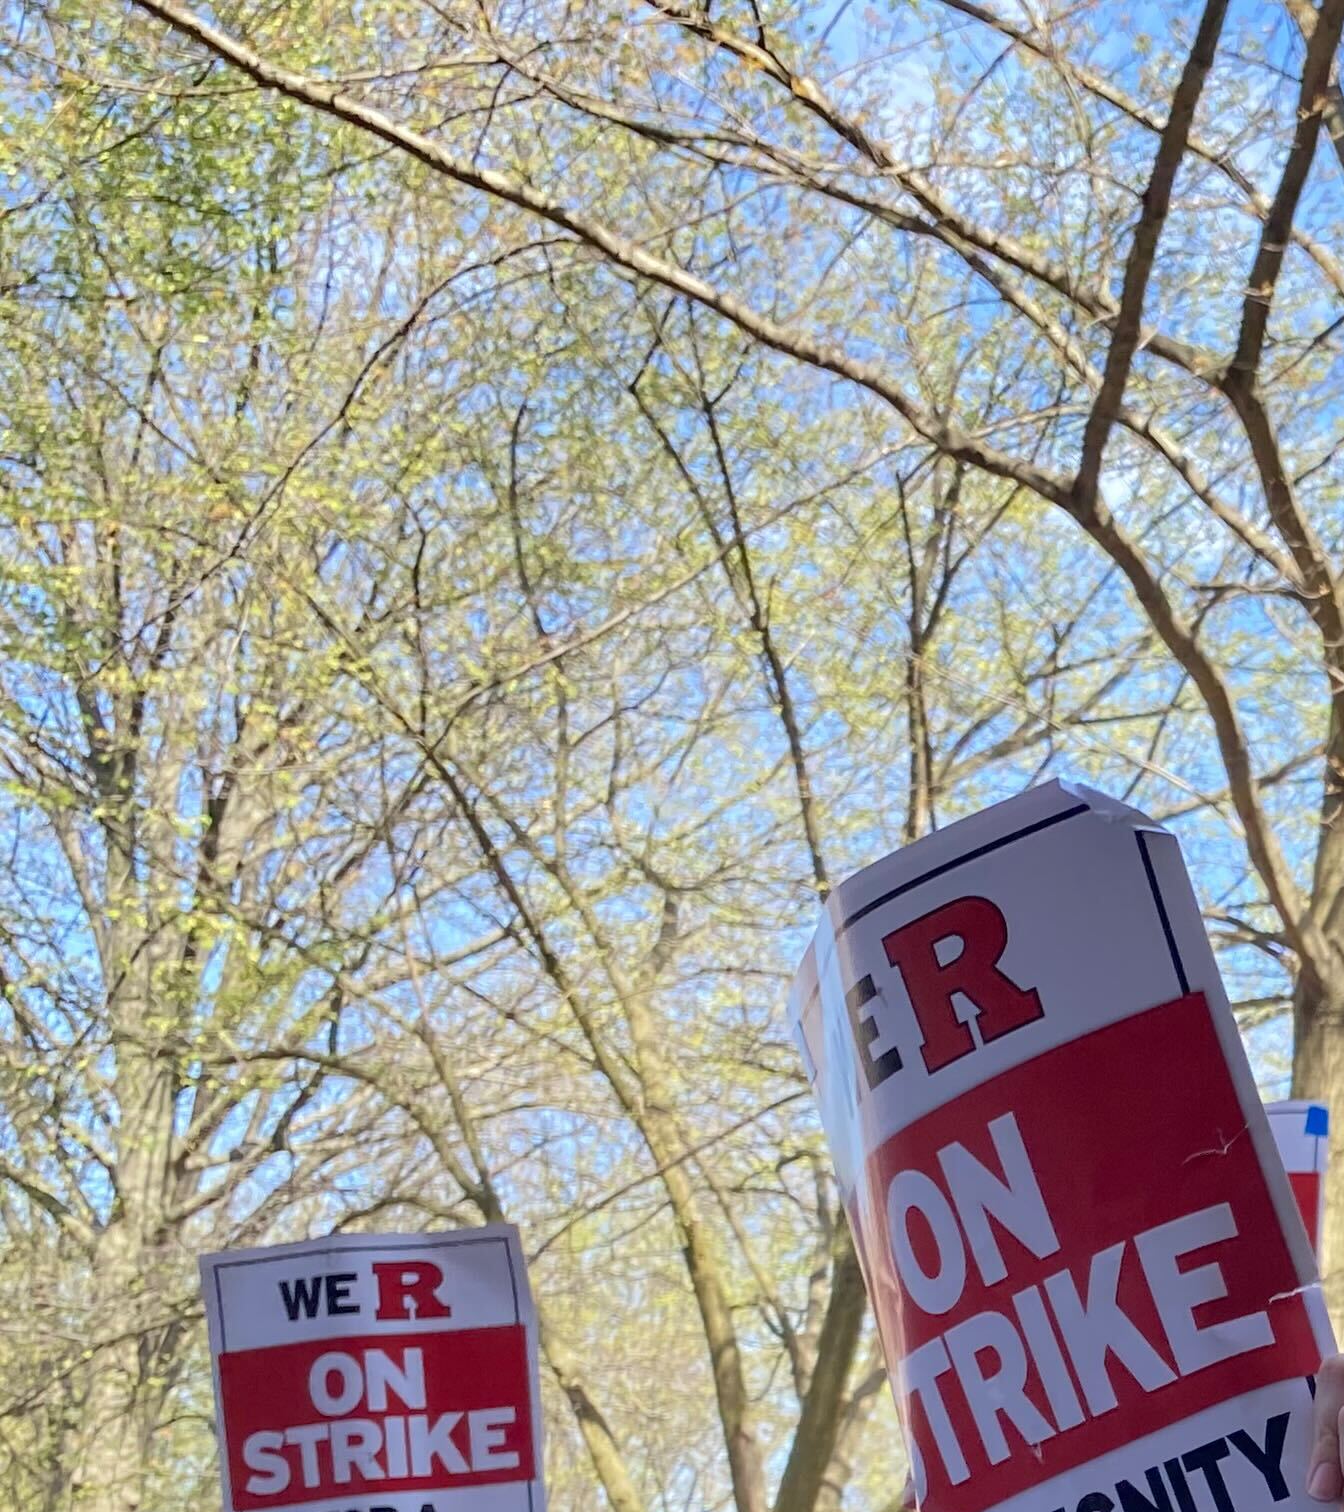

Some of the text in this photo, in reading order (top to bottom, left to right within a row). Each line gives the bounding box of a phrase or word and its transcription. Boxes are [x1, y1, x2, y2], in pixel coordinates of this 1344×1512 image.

[845, 895, 1045, 1091] E R
[887, 1111, 1061, 1316] ON
[279, 1260, 453, 1322] WE R
[897, 1201, 1276, 1487] TRIKE
[242, 1405, 521, 1497] STRIKE
[308, 1346, 427, 1418] ON
